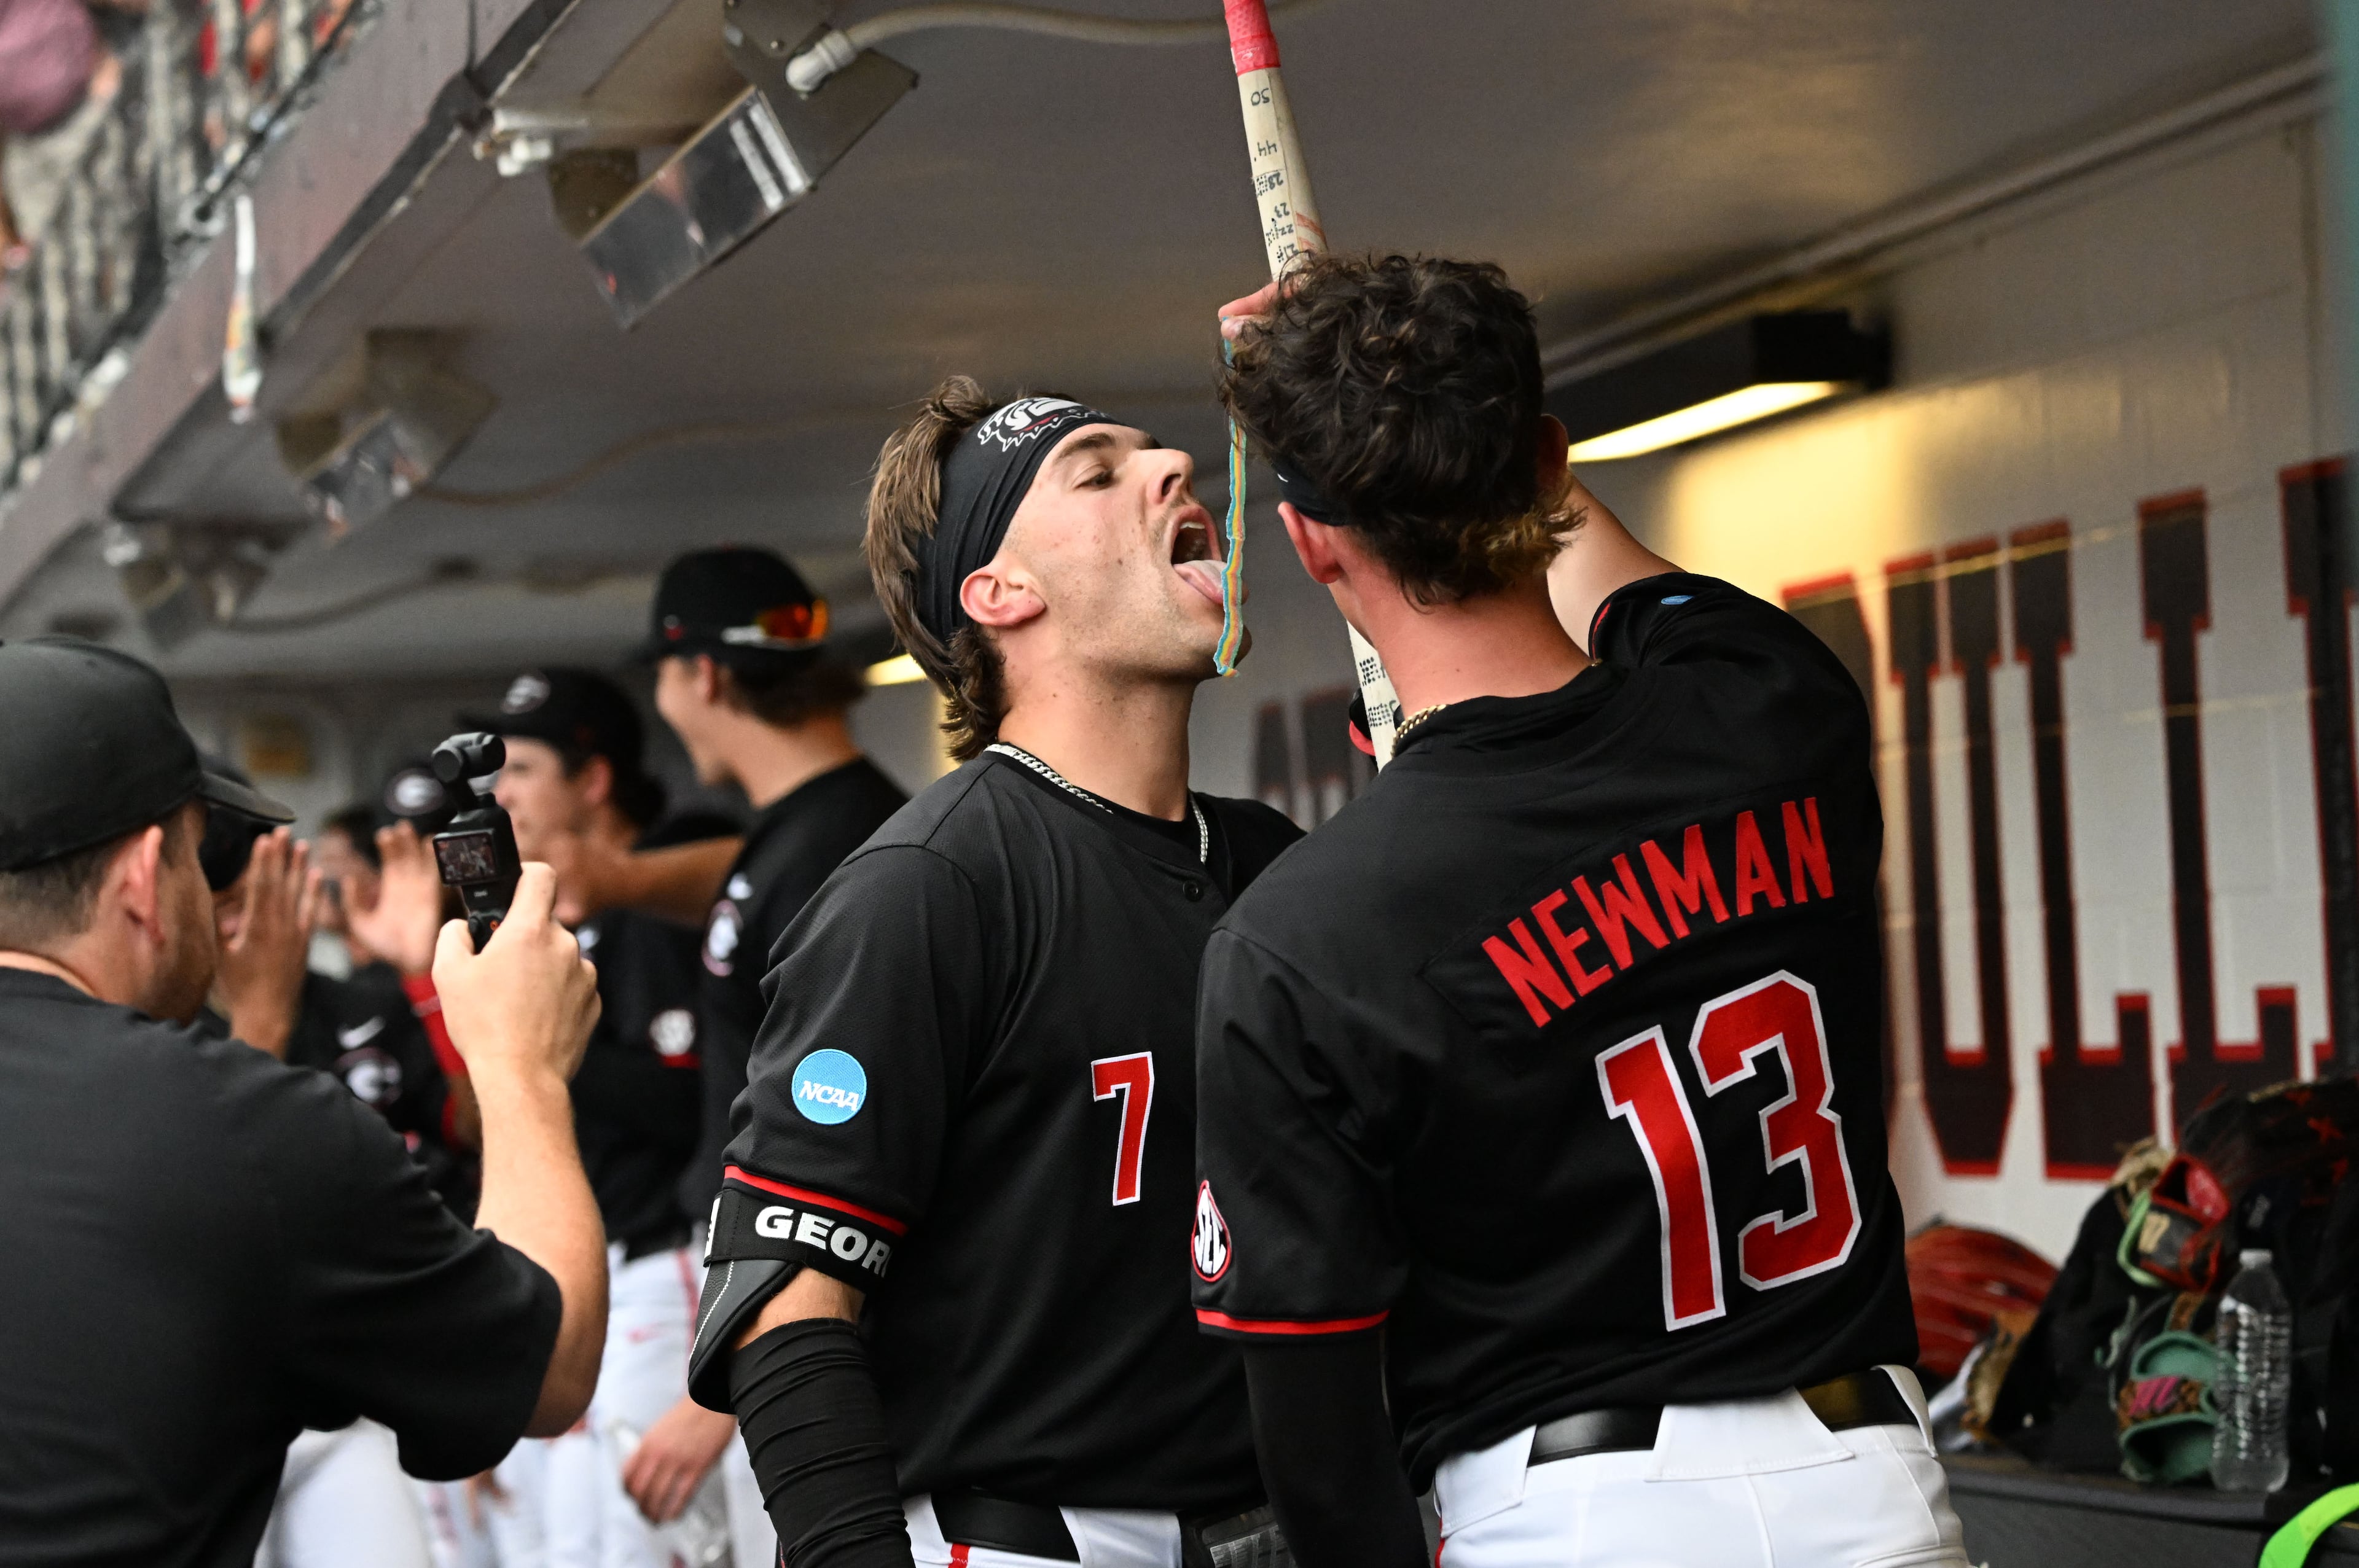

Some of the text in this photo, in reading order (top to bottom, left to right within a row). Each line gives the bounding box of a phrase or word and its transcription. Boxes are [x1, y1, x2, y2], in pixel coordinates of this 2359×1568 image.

[1251, 88, 1270, 106] 50
[1274, 202, 1290, 219] 23
[1481, 797, 1834, 1028] NEWMAN
[798, 1080, 860, 1112] NCAA
[1091, 1051, 1155, 1206] 7
[1595, 969, 1862, 1332] 13
[755, 1205, 893, 1278] GEOR
[1194, 1188, 1227, 1274] SEC
